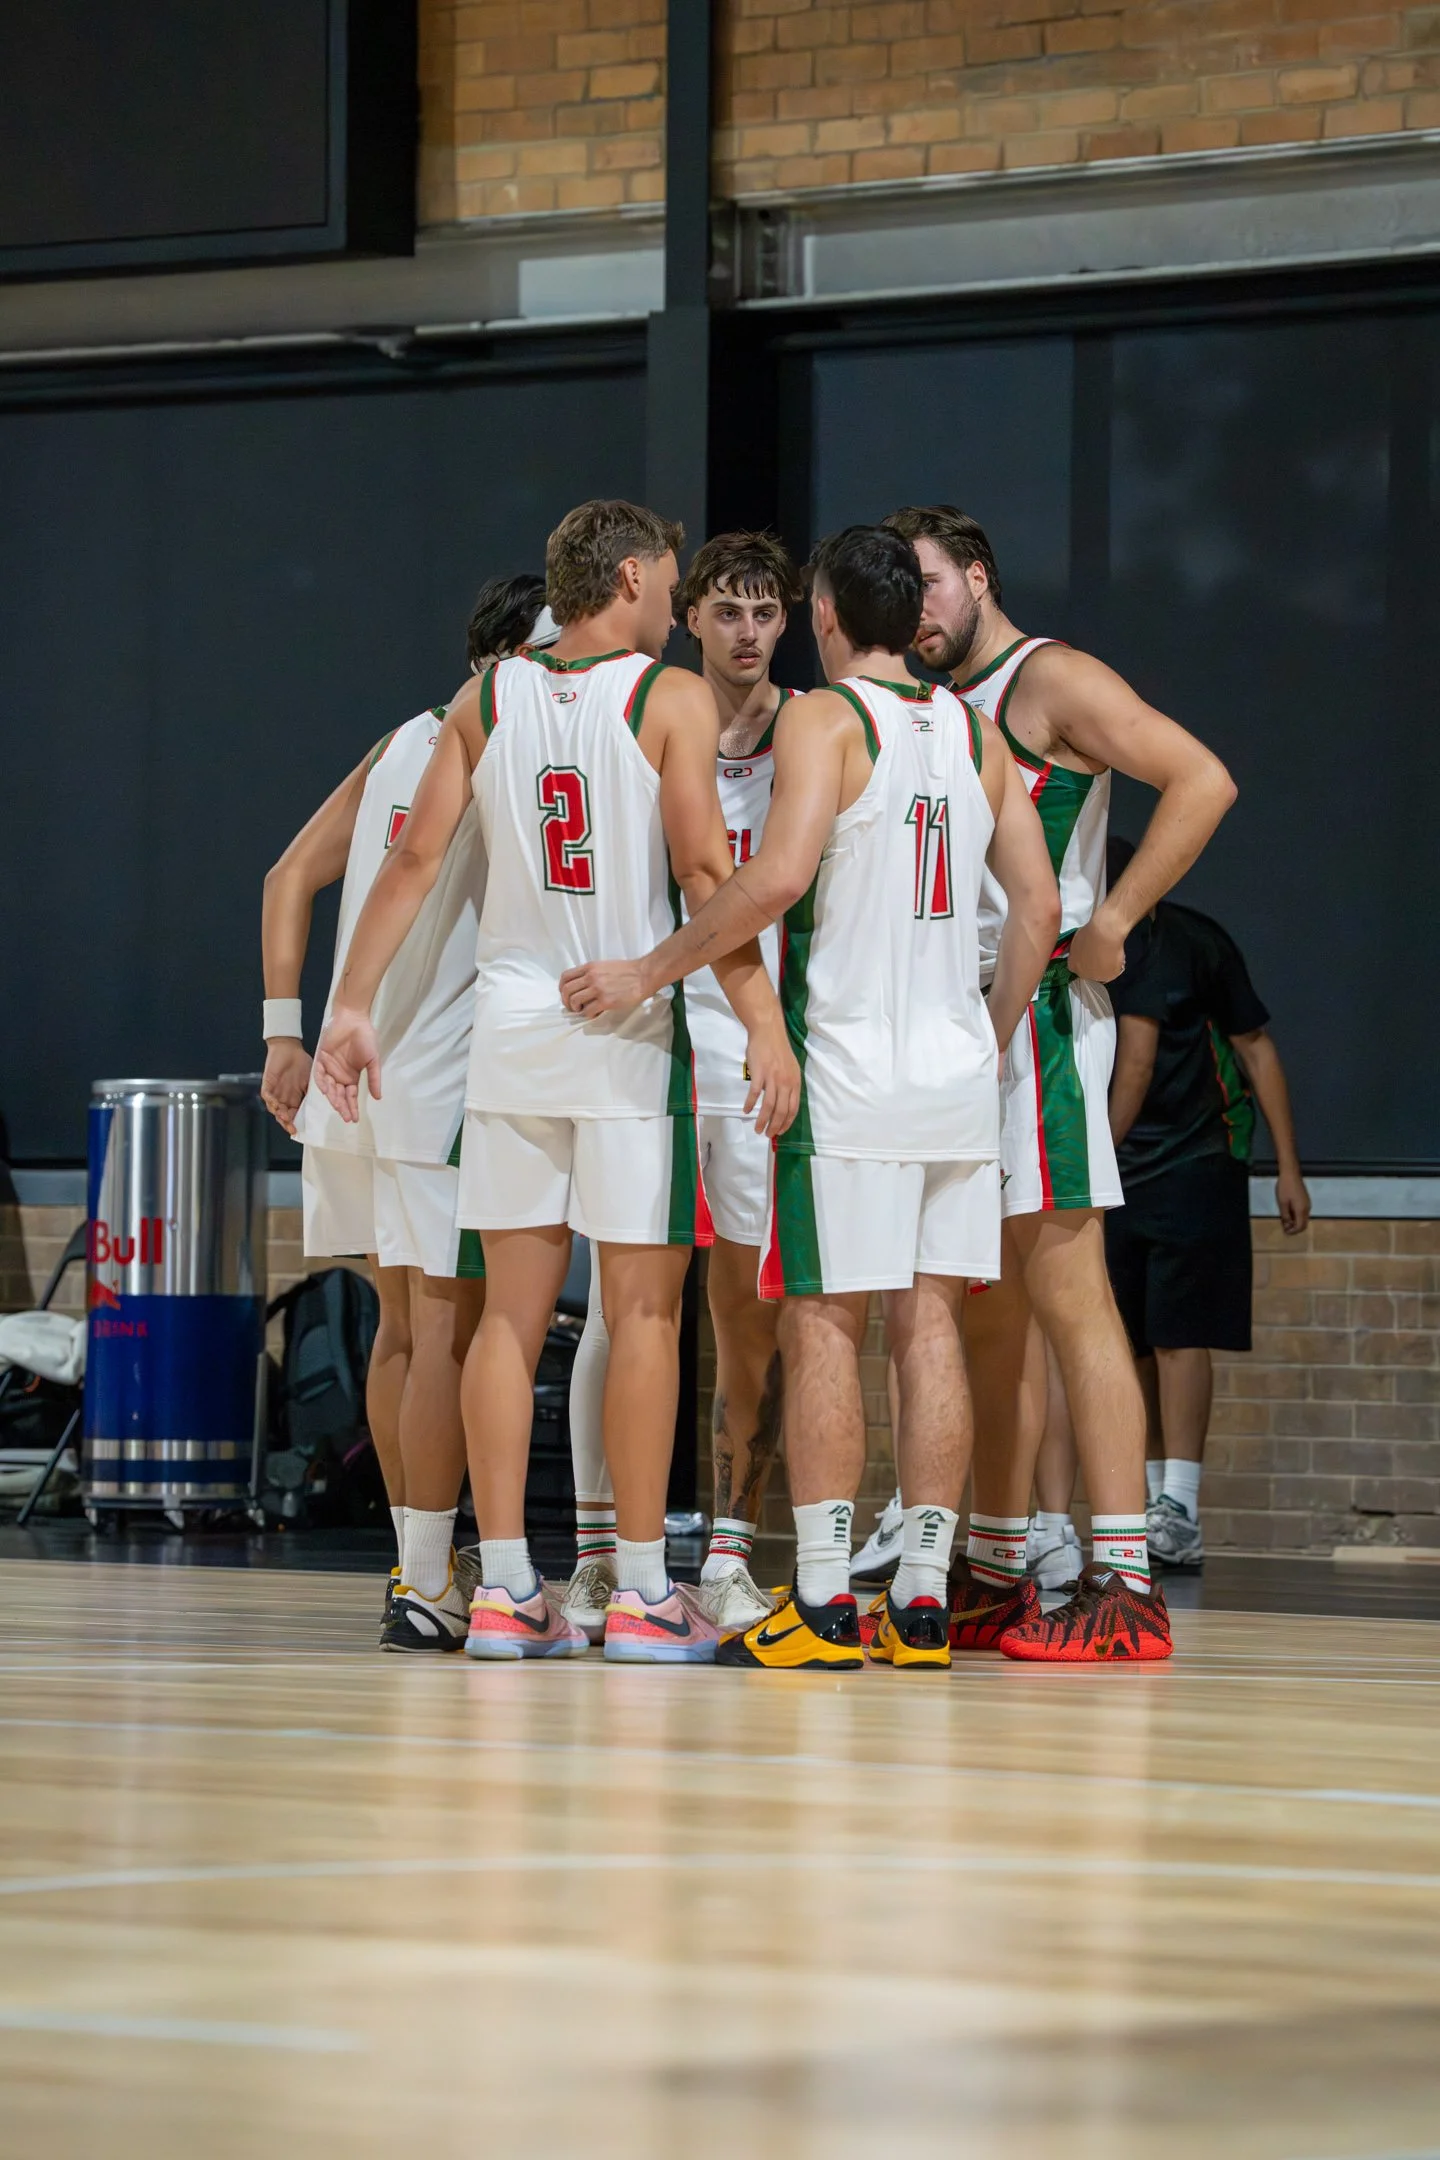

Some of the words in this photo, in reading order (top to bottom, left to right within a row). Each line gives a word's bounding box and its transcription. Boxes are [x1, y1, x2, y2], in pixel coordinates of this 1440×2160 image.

[536, 764, 596, 896] 2
[904, 793, 955, 921] 11
[93, 1216, 163, 1267] Bull
